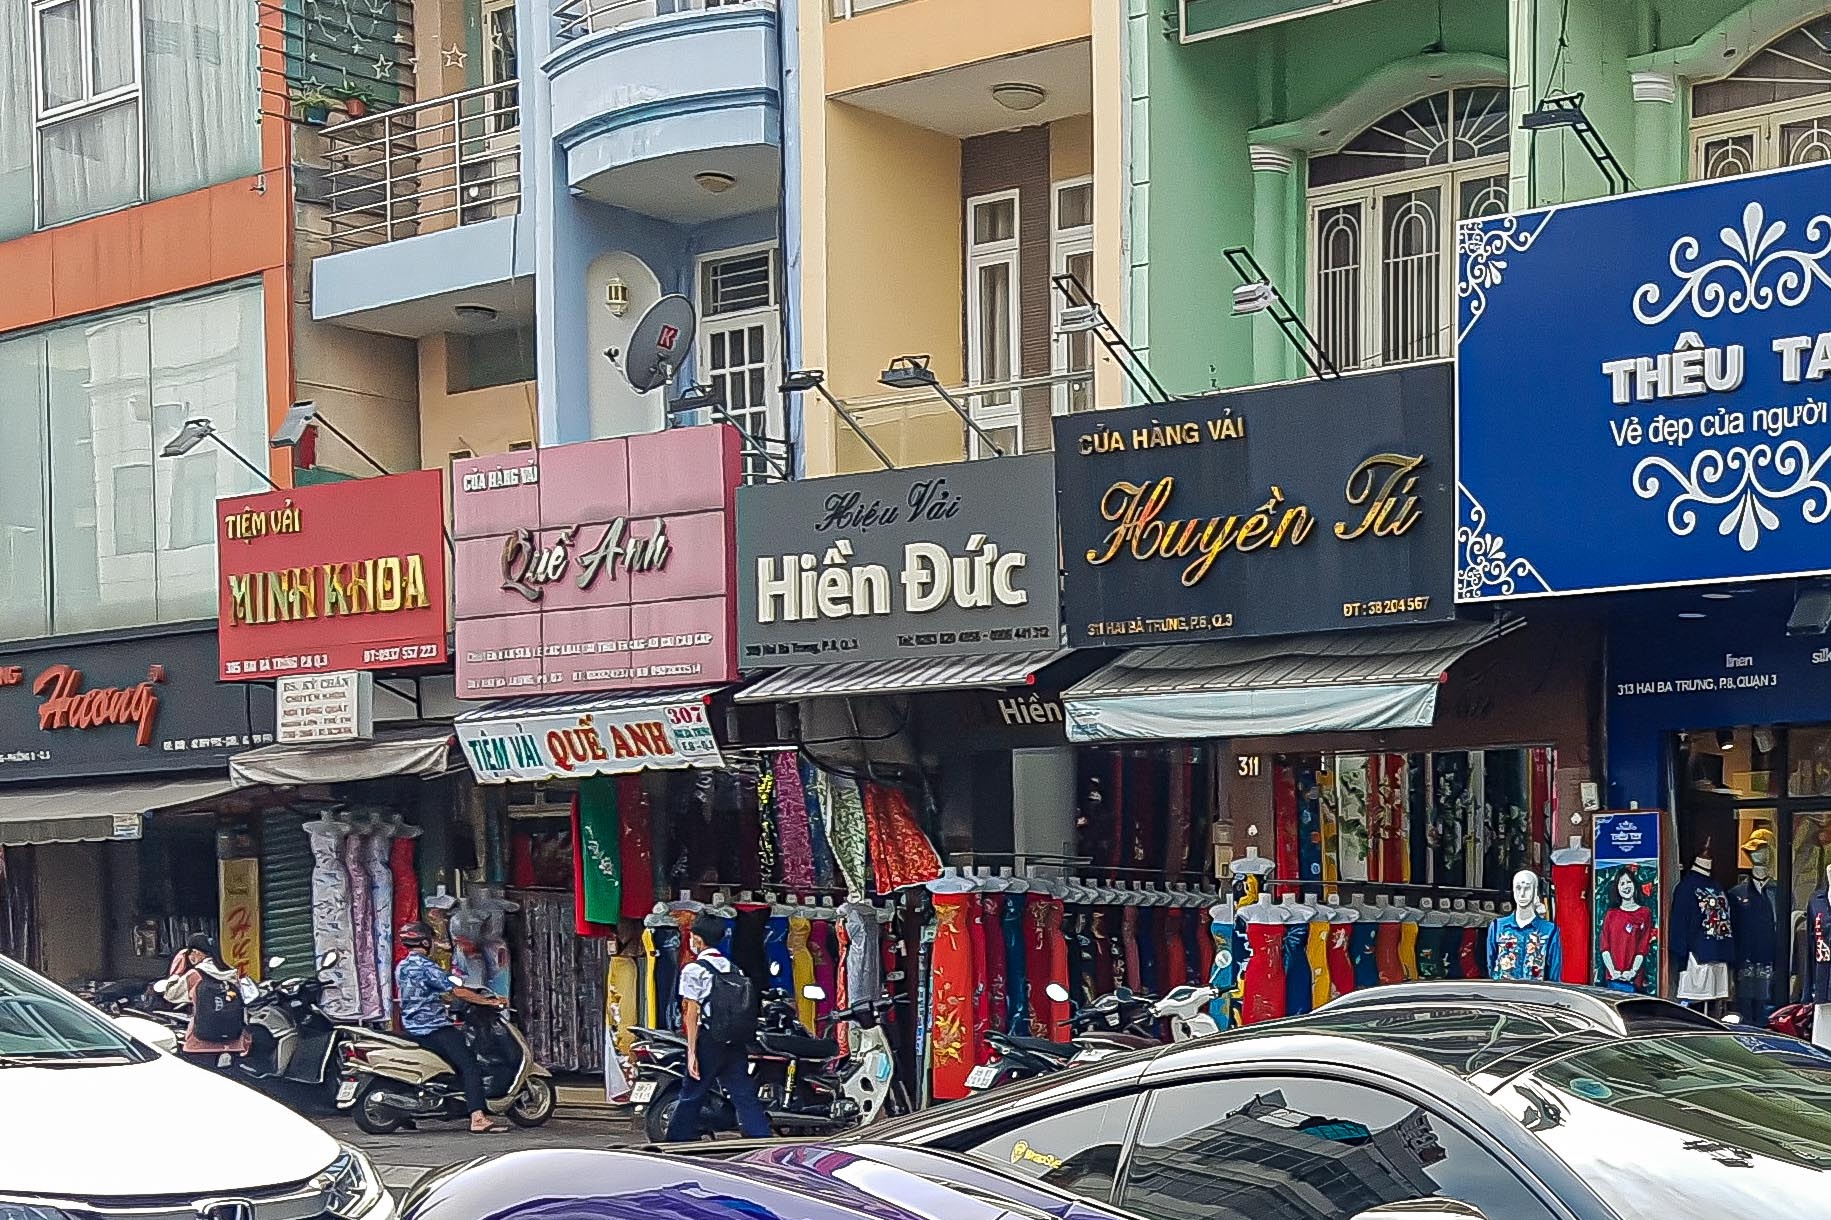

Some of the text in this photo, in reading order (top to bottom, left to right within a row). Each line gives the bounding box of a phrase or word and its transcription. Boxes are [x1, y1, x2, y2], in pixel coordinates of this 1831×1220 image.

[1602, 331, 1744, 404] THÊU
[1132, 419, 1200, 450] HÀNG
[1207, 408, 1246, 440] VẢI
[1610, 419, 1642, 447] Vẻ
[1649, 415, 1693, 446] đẹp
[1700, 407, 1744, 437] của
[1753, 398, 1827, 436] người
[225, 498, 302, 544] TIỆM VẢI
[907, 479, 961, 524] Vải
[1087, 453, 1424, 588] Huyền Tú
[500, 515, 672, 602] Quế Anh
[757, 533, 1028, 623] Hiền Đức
[227, 553, 431, 627] MINH KHOA
[1617, 683, 1635, 696] 313
[1636, 682, 1655, 695] HAI
[1770, 674, 1777, 686] 3
[667, 706, 703, 725] 307
[998, 692, 1063, 726] Hiền
[468, 714, 674, 779] TIỆM VẢI QUẾ ANH
[1238, 756, 1259, 776] 311
